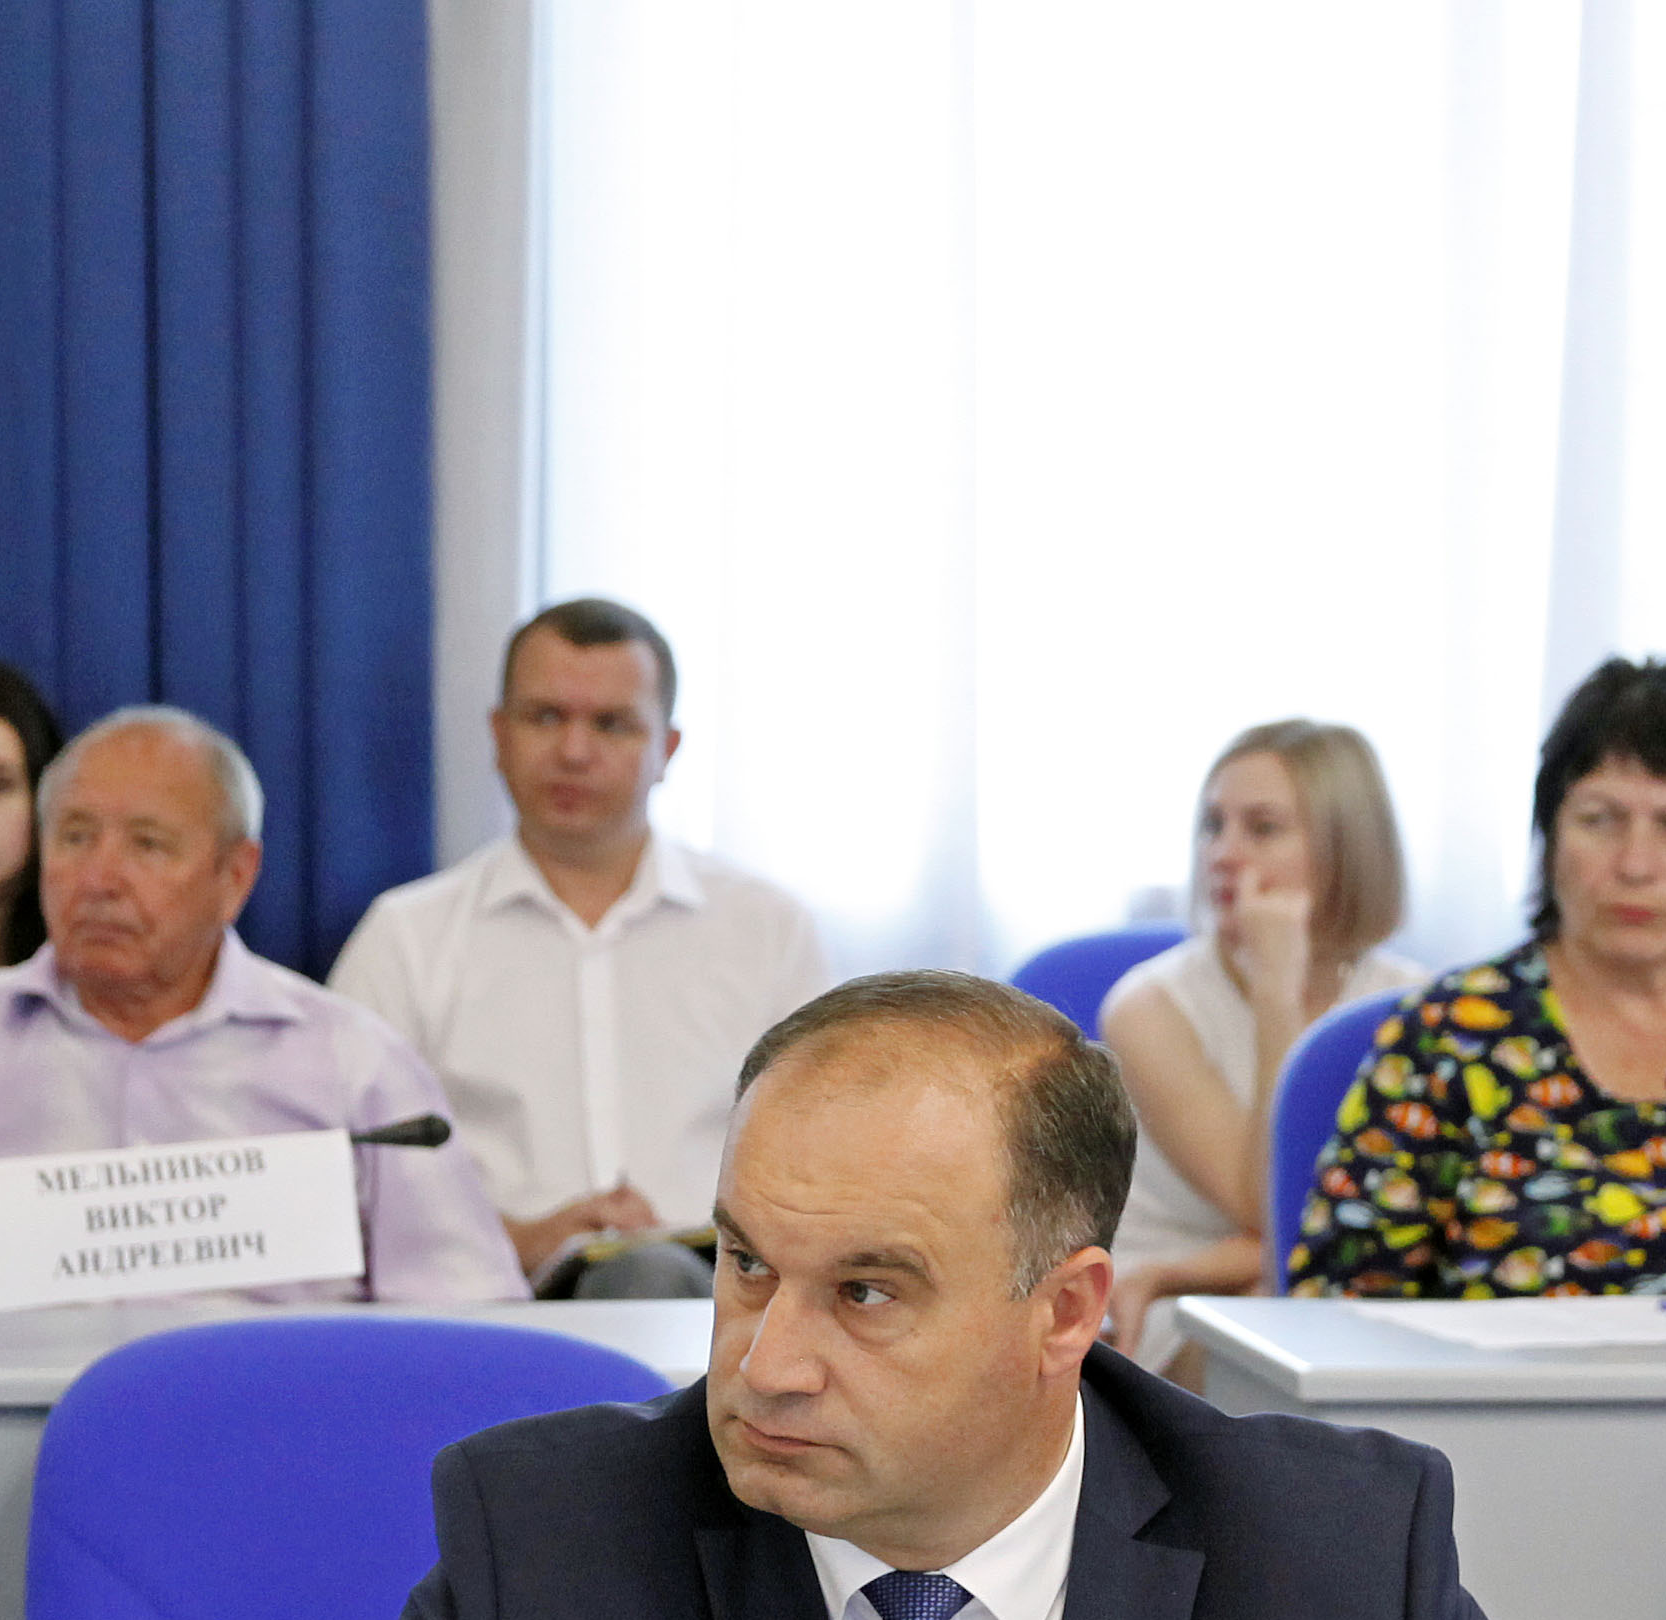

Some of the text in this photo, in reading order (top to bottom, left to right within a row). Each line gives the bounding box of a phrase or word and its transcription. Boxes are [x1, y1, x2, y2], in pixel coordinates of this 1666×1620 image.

[37, 1147, 265, 1193] МЕЛЬНИКОВ
[85, 1195, 227, 1232] ВИКТОР
[55, 1232, 266, 1278] АНДРЕЕВИЧ
